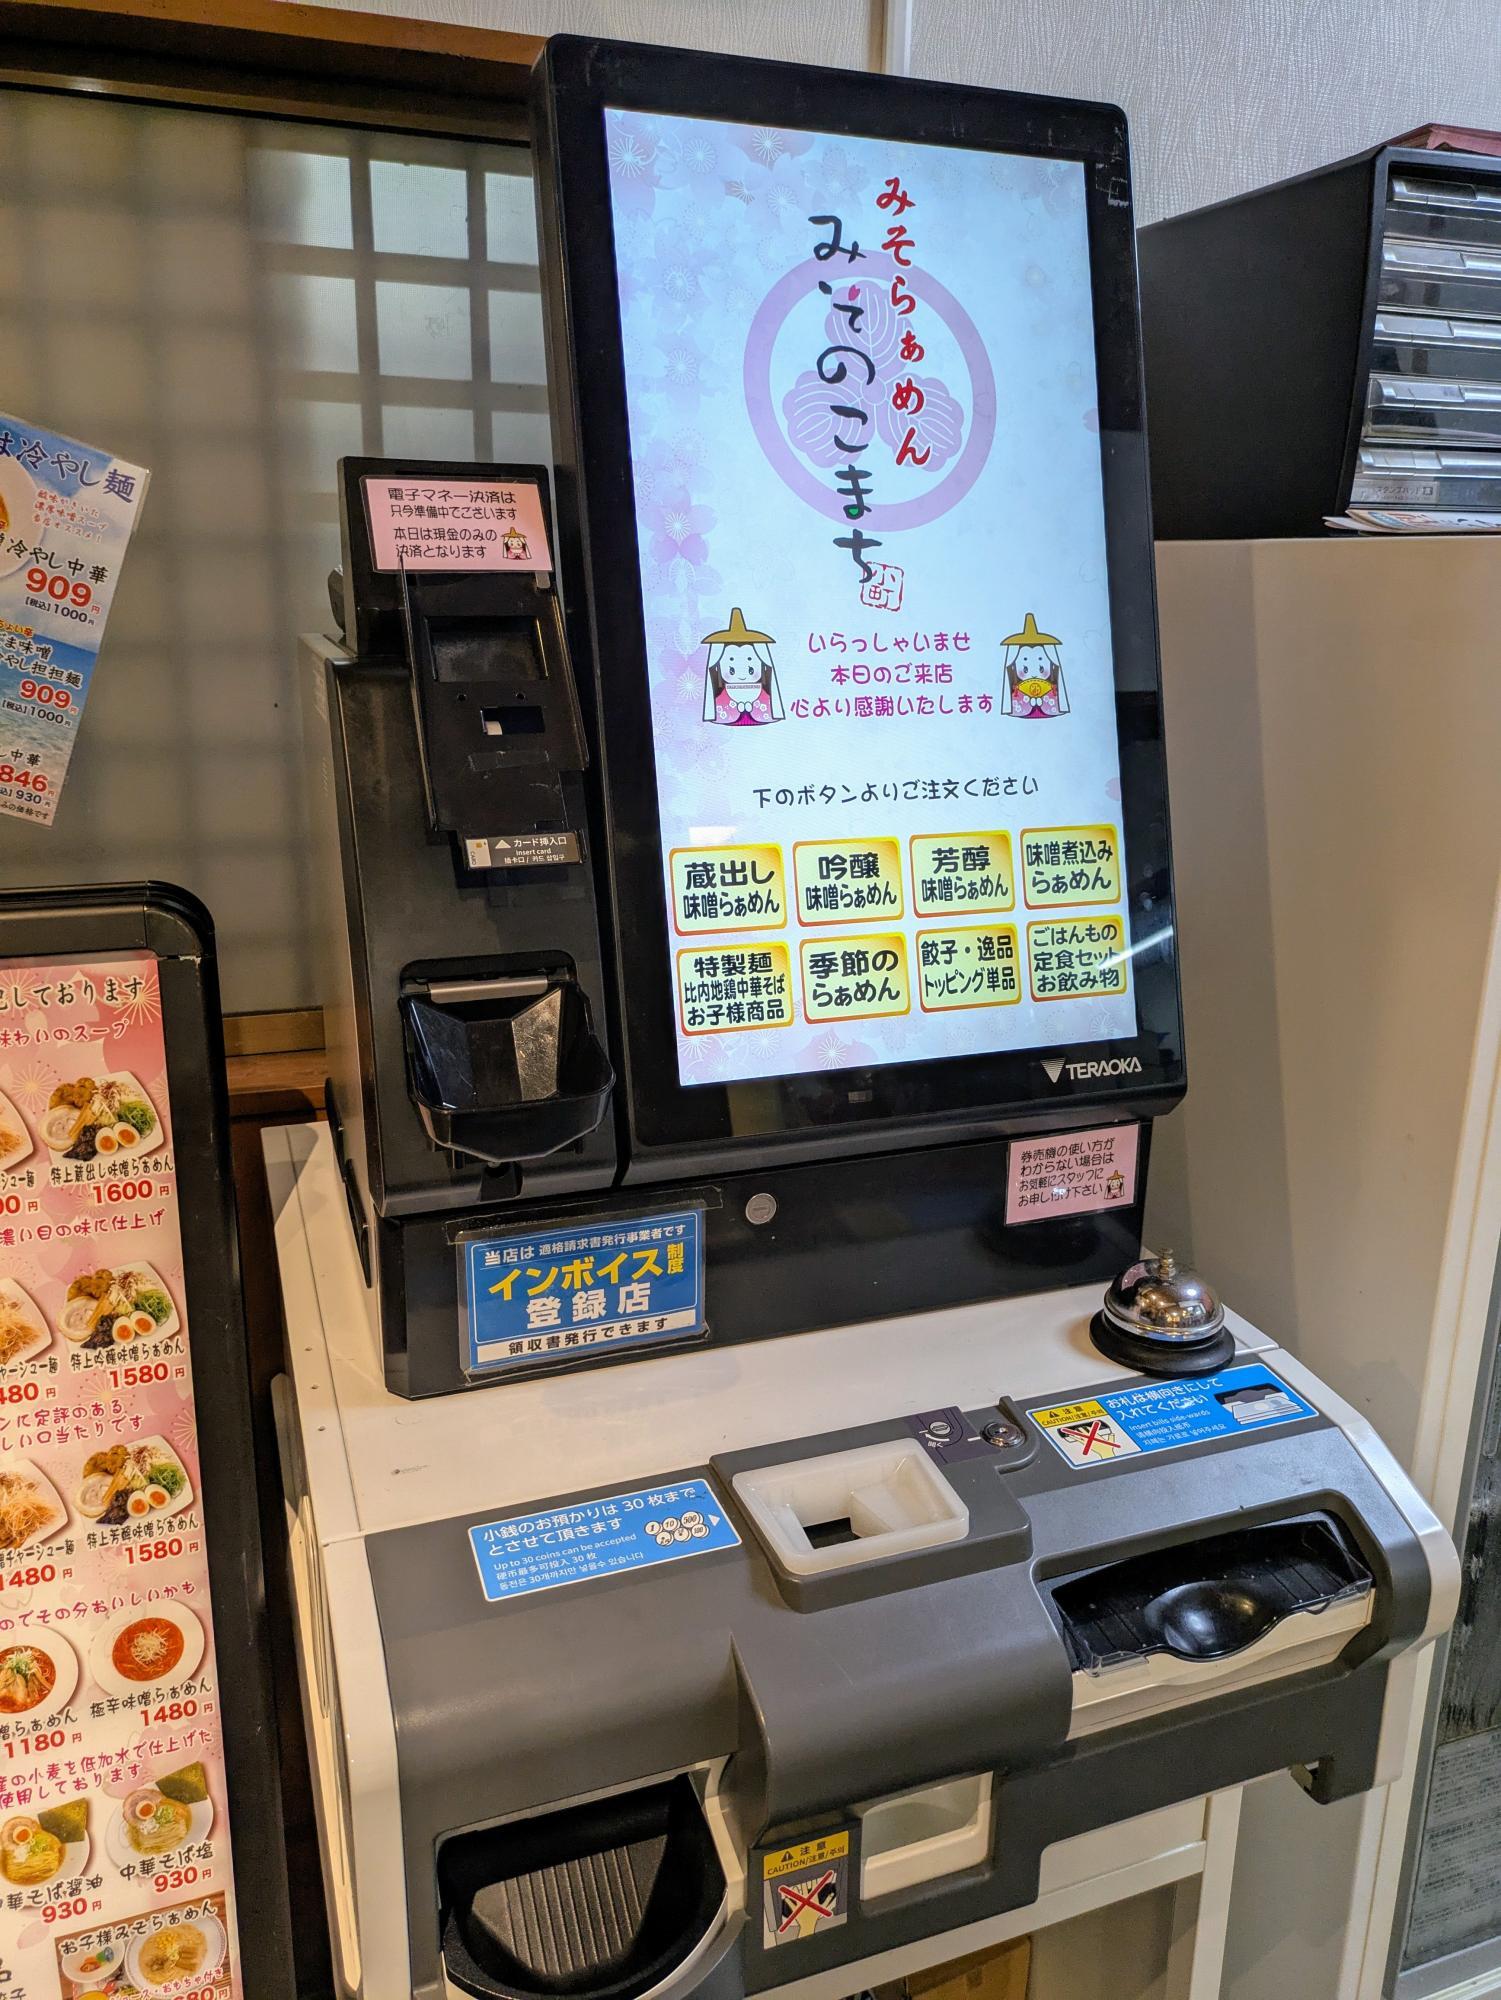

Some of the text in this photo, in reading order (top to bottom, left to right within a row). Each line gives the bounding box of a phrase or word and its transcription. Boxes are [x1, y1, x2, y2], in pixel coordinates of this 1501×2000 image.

[876, 177, 930, 466] みそらぁめん
[388, 487, 516, 504] 電子マネー決済は
[393, 526, 497, 541] 本日は現金のみの
[0, 532, 108, 584] 冷やし中華
[395, 544, 487, 559] 決済となります
[809, 632, 971, 653] いらっしゃいませ
[830, 664, 953, 685] 本日のご来店
[790, 694, 993, 718] 心より感謝いたします
[753, 776, 1039, 808] 下のボタンよりご注文ください
[514, 836, 567, 847] カード挿入口
[1026, 840, 1113, 866] 味噌煮込み
[818, 854, 880, 879] 吟醸
[932, 846, 991, 873] 芳醇
[684, 858, 775, 890] 蔵出し
[921, 874, 1009, 902] 味噌らぁめん
[1031, 867, 1111, 895] らぁめん
[683, 890, 780, 920] 味噌らぁめん
[805, 882, 897, 911] 味噌らぁめん
[1033, 924, 1117, 947] ごはんもの
[809, 949, 899, 977] 季節の
[921, 935, 1014, 966] 餃子・逸品
[1034, 947, 1120, 972] 定食セット
[694, 953, 774, 977] 特製麺
[684, 973, 785, 1003] 比内地鶏中華そば
[812, 977, 901, 1009] らぁめん
[925, 966, 1016, 997] トッピング単品
[1037, 967, 1119, 993] お飲み物
[687, 999, 785, 1027] お子様商品
[1065, 1056, 1142, 1081] TERAOKA
[1021, 1137, 1115, 1164] 券売機の使い方が
[1021, 1152, 1114, 1177] わからない場合は
[1020, 1168, 1103, 1192] お気軽にスタッフに
[489, 1243, 684, 1300] インボイス 制度
[526, 1282, 650, 1329] 登録店
[508, 1318, 668, 1356] 領収書発行できます
[1106, 1377, 1223, 1409] お札は横向きにして
[1116, 1395, 1209, 1421] 入れてください
[483, 1505, 619, 1543] 小銭のお預かりは
[624, 1497, 645, 1512] 30
[488, 1518, 623, 1557] とさせて頂きます
[493, 1534, 636, 1572] Up to 30 coins can be accepted
[120, 1843, 213, 1881] 中華そば塩
[0, 1874, 103, 1910] 華そば醤油
